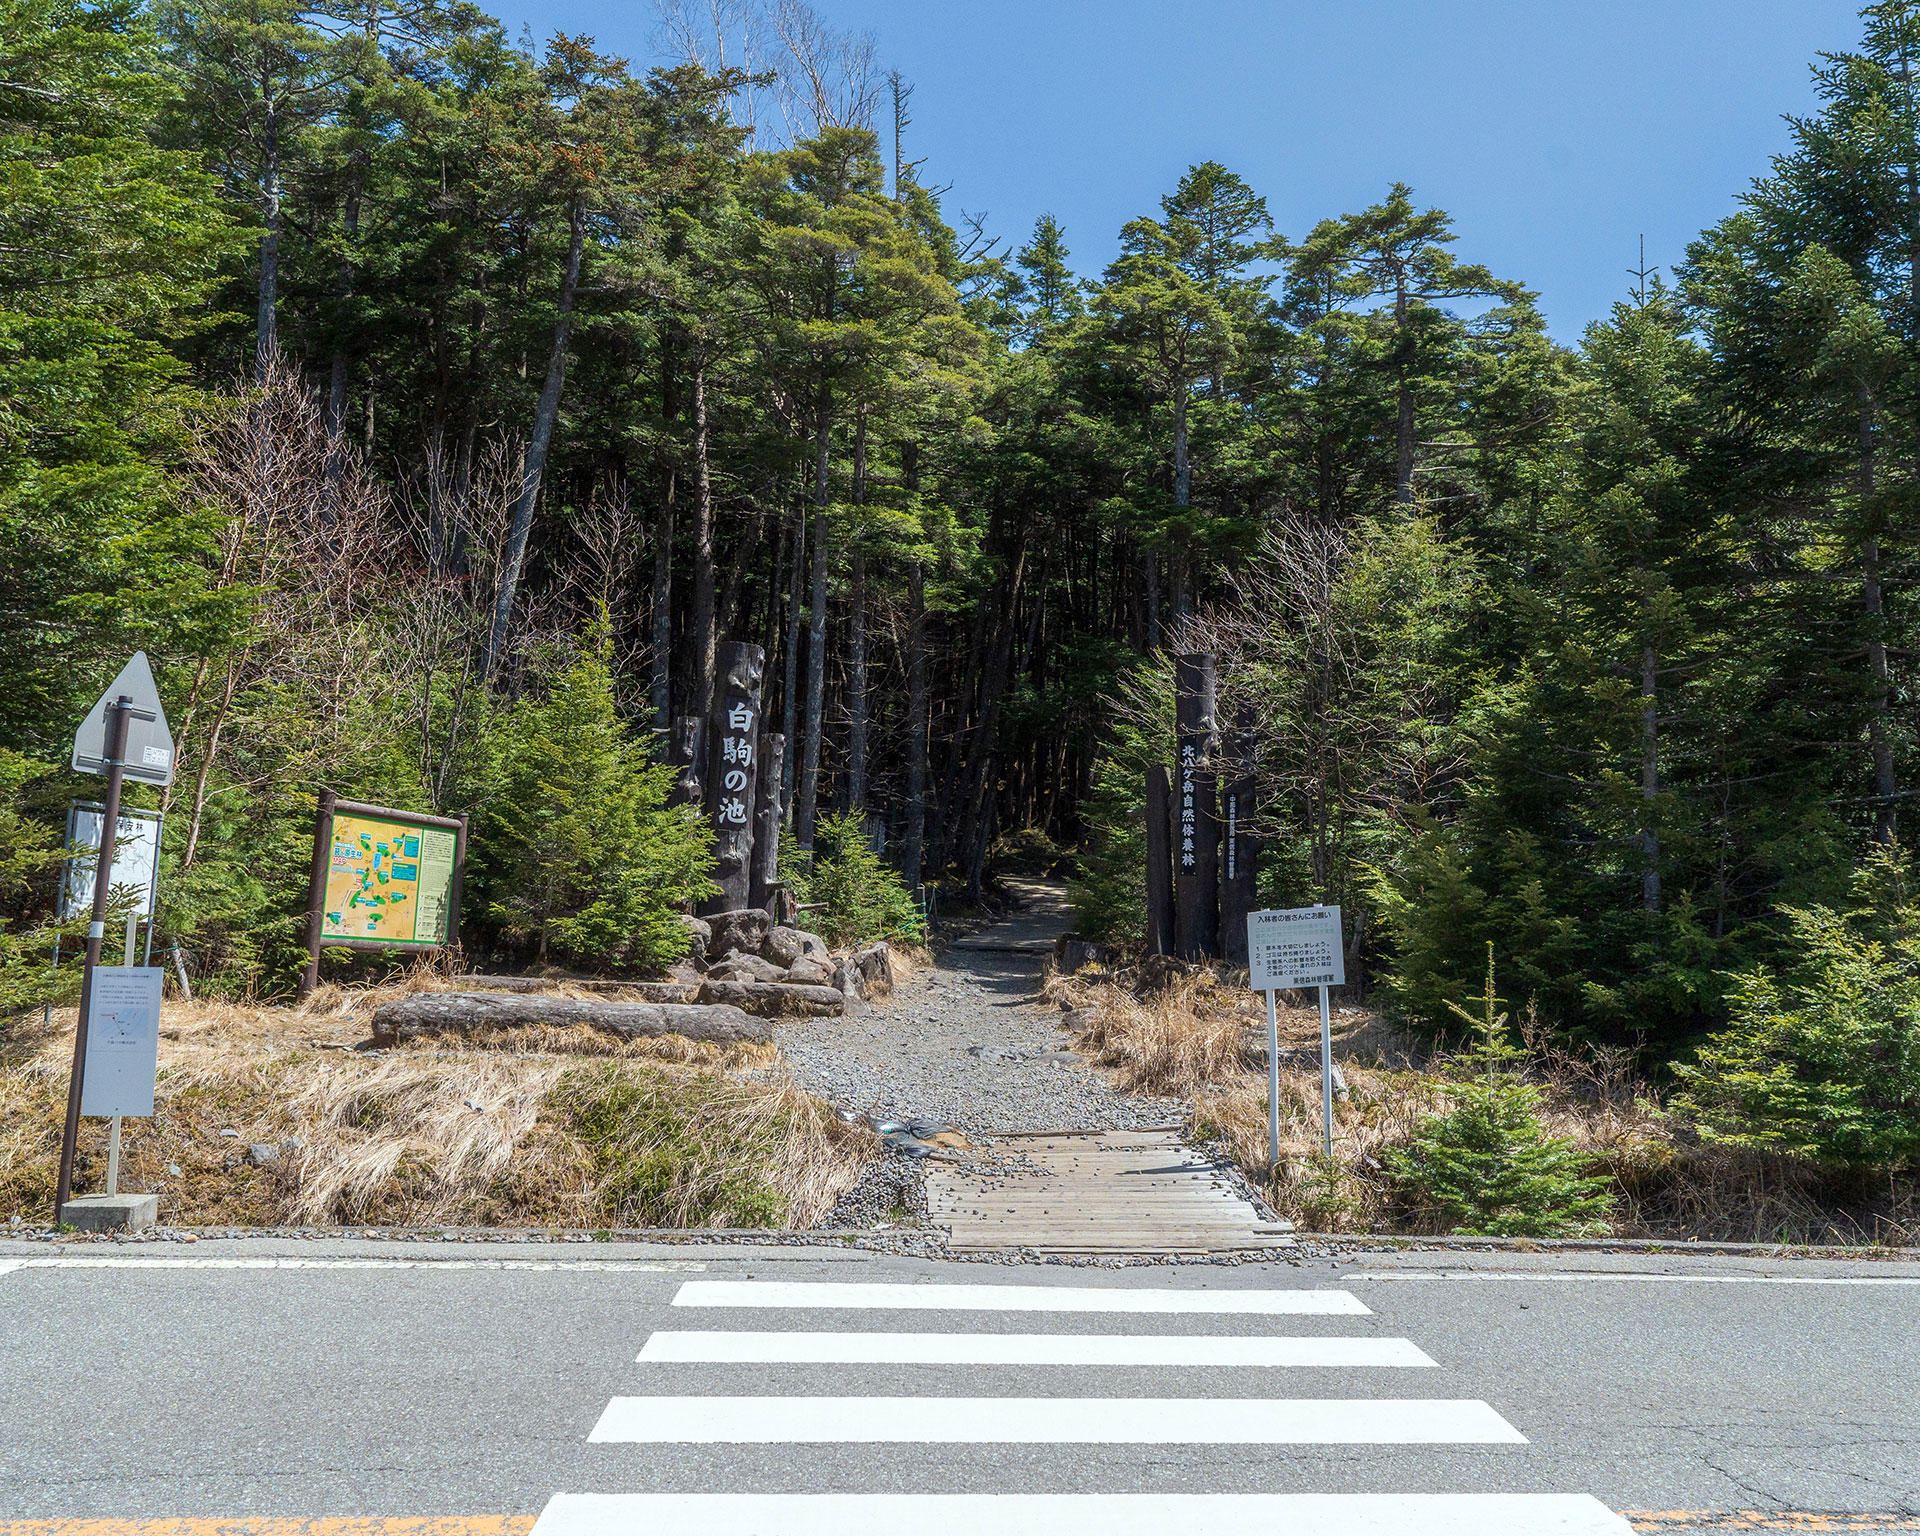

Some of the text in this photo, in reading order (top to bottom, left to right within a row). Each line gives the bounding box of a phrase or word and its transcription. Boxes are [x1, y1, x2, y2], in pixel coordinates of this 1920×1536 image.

[718, 702, 753, 824] 白駒の池
[1257, 911, 1331, 924] 入林者の皆さんにお願い
[1266, 941, 1330, 951] 草木を大切にしましょう。
[1266, 948, 1330, 959] ゴミは持ち帰りましょう。
[1266, 955, 1331, 965] 生態系への影響を防ぐため
[1266, 969, 1309, 977] ご遠慮ください。
